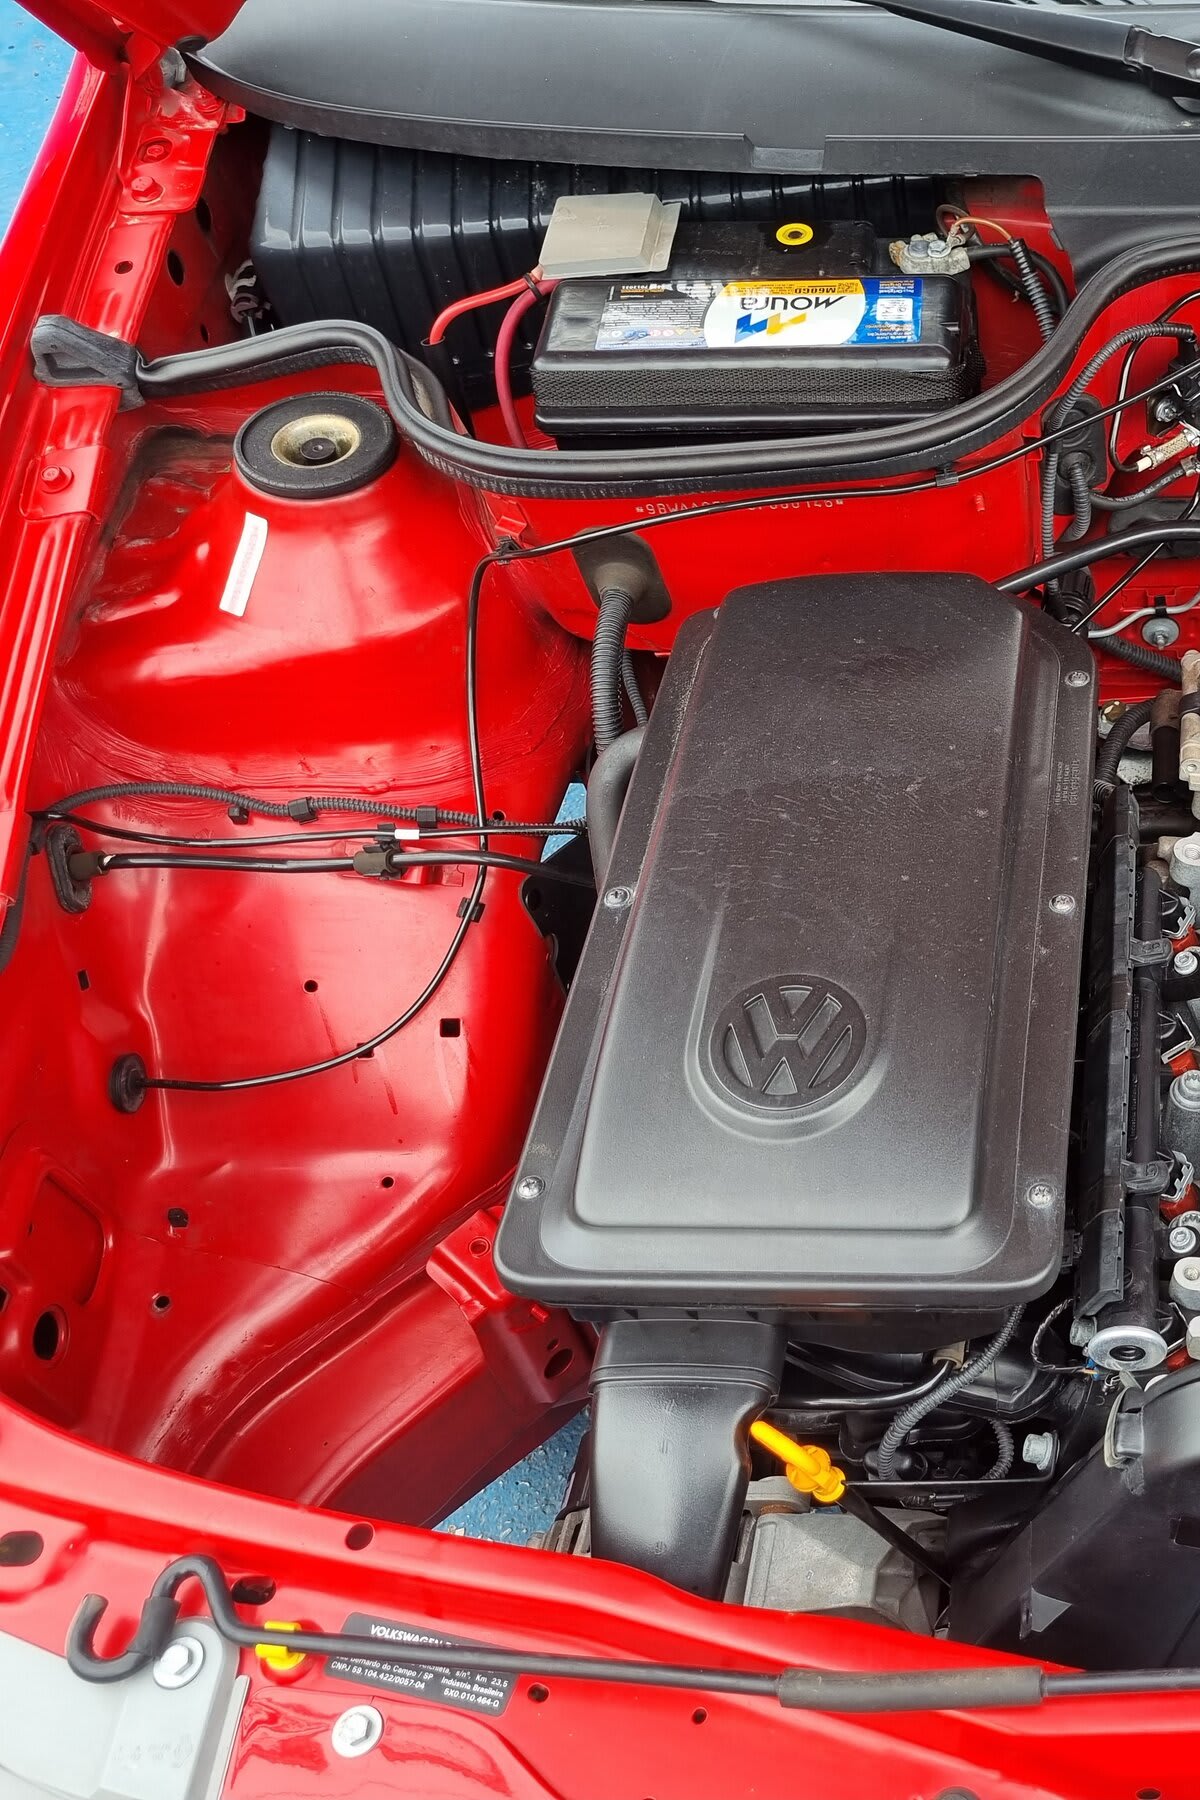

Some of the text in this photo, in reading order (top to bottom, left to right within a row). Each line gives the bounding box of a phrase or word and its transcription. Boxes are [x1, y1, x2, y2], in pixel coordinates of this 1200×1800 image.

[331, 1660, 351, 1672] CNPJ
[382, 1661, 392, 1671] do
[393, 1664, 417, 1678] Campo
[423, 1671, 434, 1680] SP
[441, 1676, 472, 1690] Indústria
[473, 1683, 504, 1698] Brasileira
[476, 1674, 488, 1684] Km
[490, 1676, 509, 1688] 23,5
